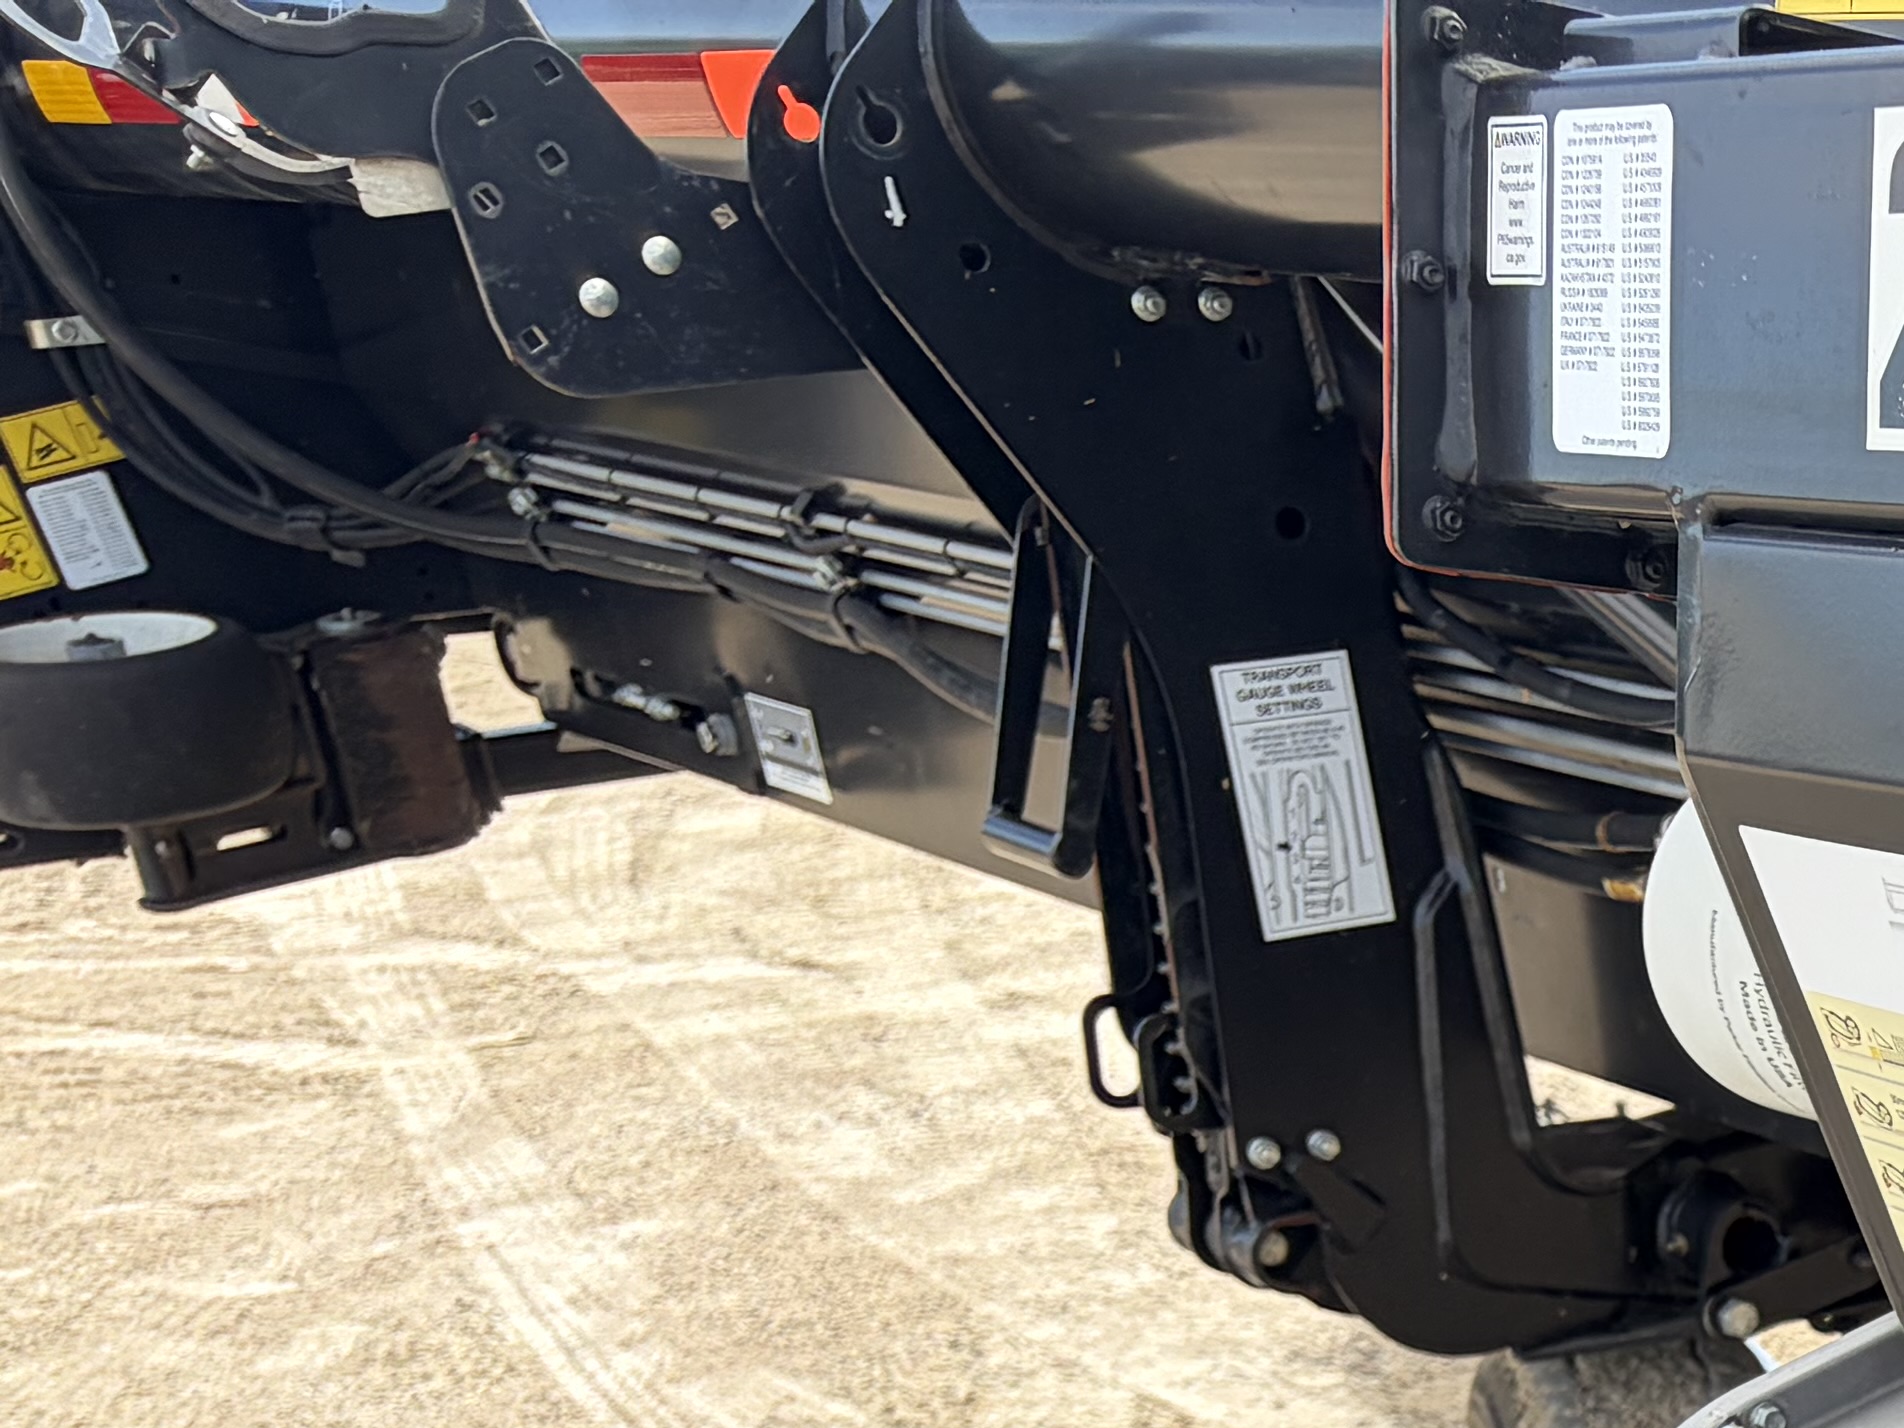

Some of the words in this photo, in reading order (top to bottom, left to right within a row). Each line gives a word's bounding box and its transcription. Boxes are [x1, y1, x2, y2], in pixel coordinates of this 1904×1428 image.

[1502, 131, 1541, 146] WARNING
[1241, 663, 1322, 684] TRANSPORT
[1235, 685, 1284, 703] GAUGE
[1287, 678, 1336, 695] WHEEL
[1255, 696, 1323, 717] SETTINGS
[1739, 980, 1758, 1033] Made
